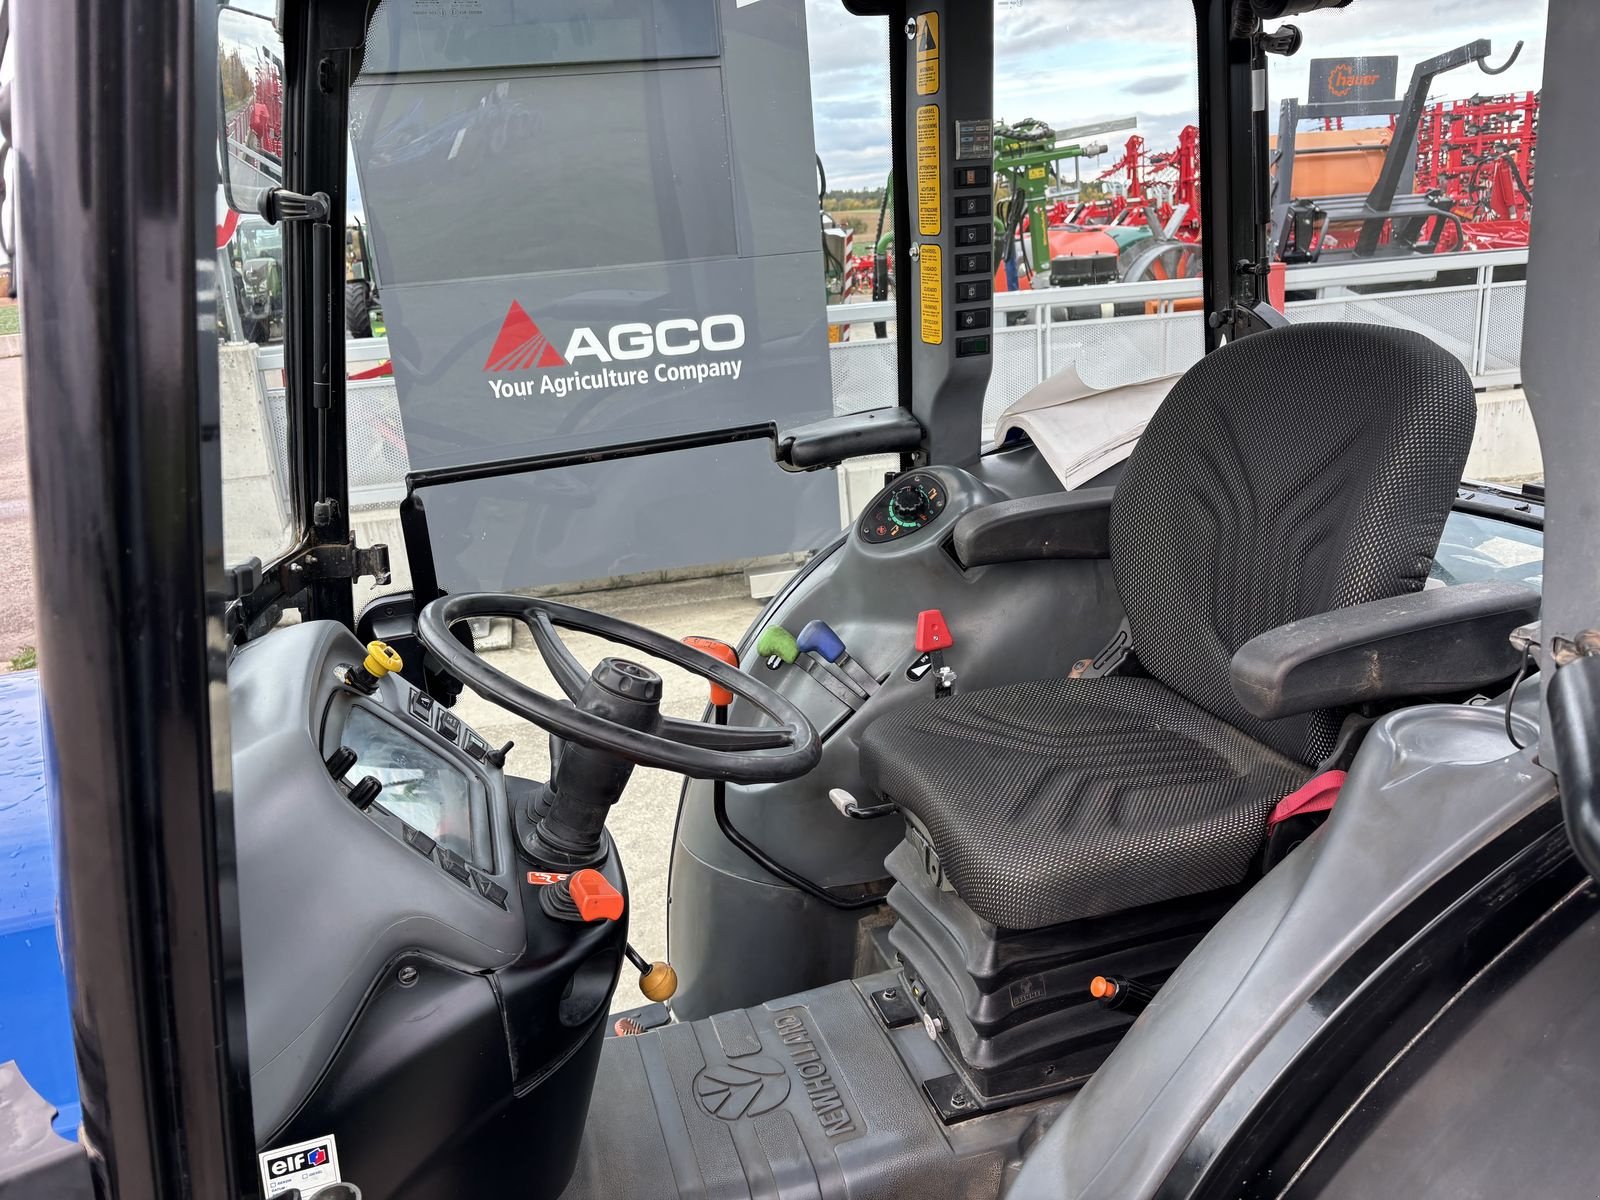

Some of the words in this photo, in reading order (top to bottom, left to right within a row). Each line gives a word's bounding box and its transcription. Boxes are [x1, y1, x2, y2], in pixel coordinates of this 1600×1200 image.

[564, 314, 746, 365] AGCO
[488, 379, 535, 399] Your
[540, 367, 649, 398] Agriculture
[654, 359, 743, 383] Company
[271, 1153, 306, 1175] elf
